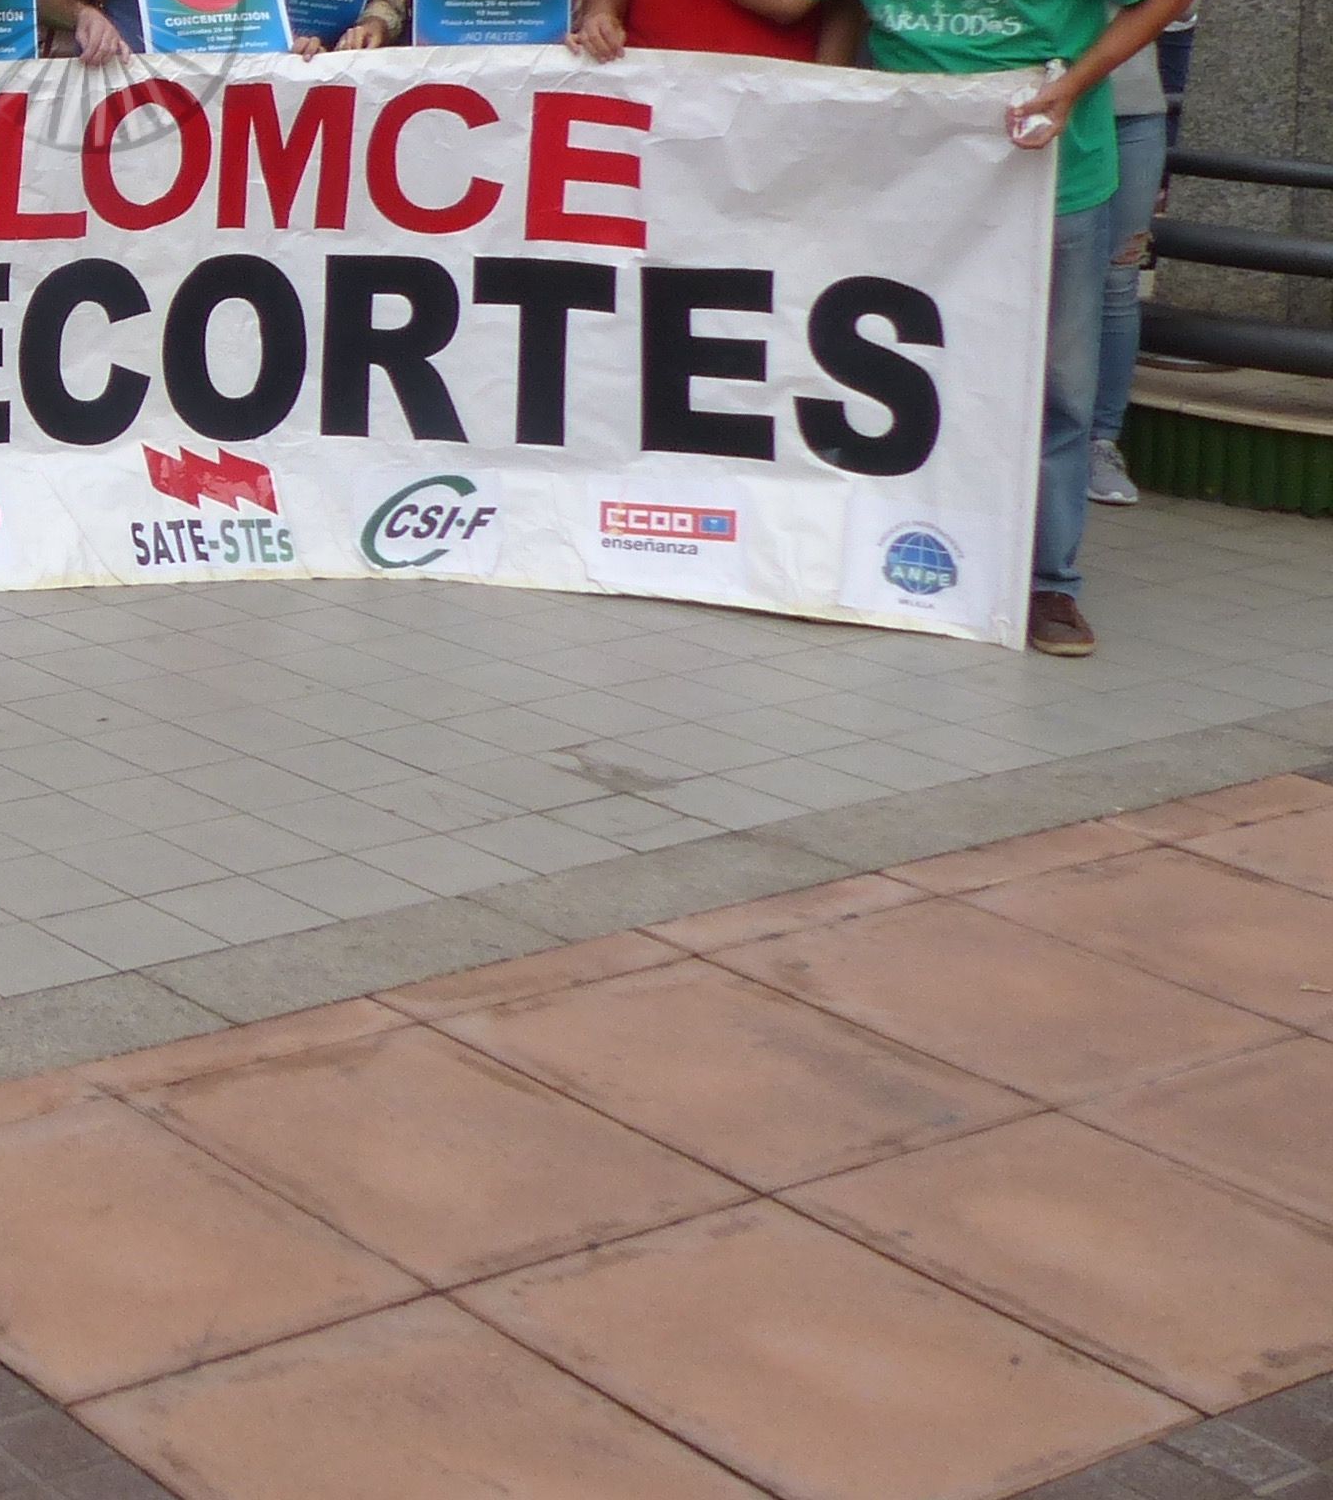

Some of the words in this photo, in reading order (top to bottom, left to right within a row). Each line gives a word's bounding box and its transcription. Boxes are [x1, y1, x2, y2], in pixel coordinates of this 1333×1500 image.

[165, 10, 270, 27] CONCENTRACIÓN
[131, 517, 294, 567] SATE-STEs
[601, 536, 698, 556] enseñanza
